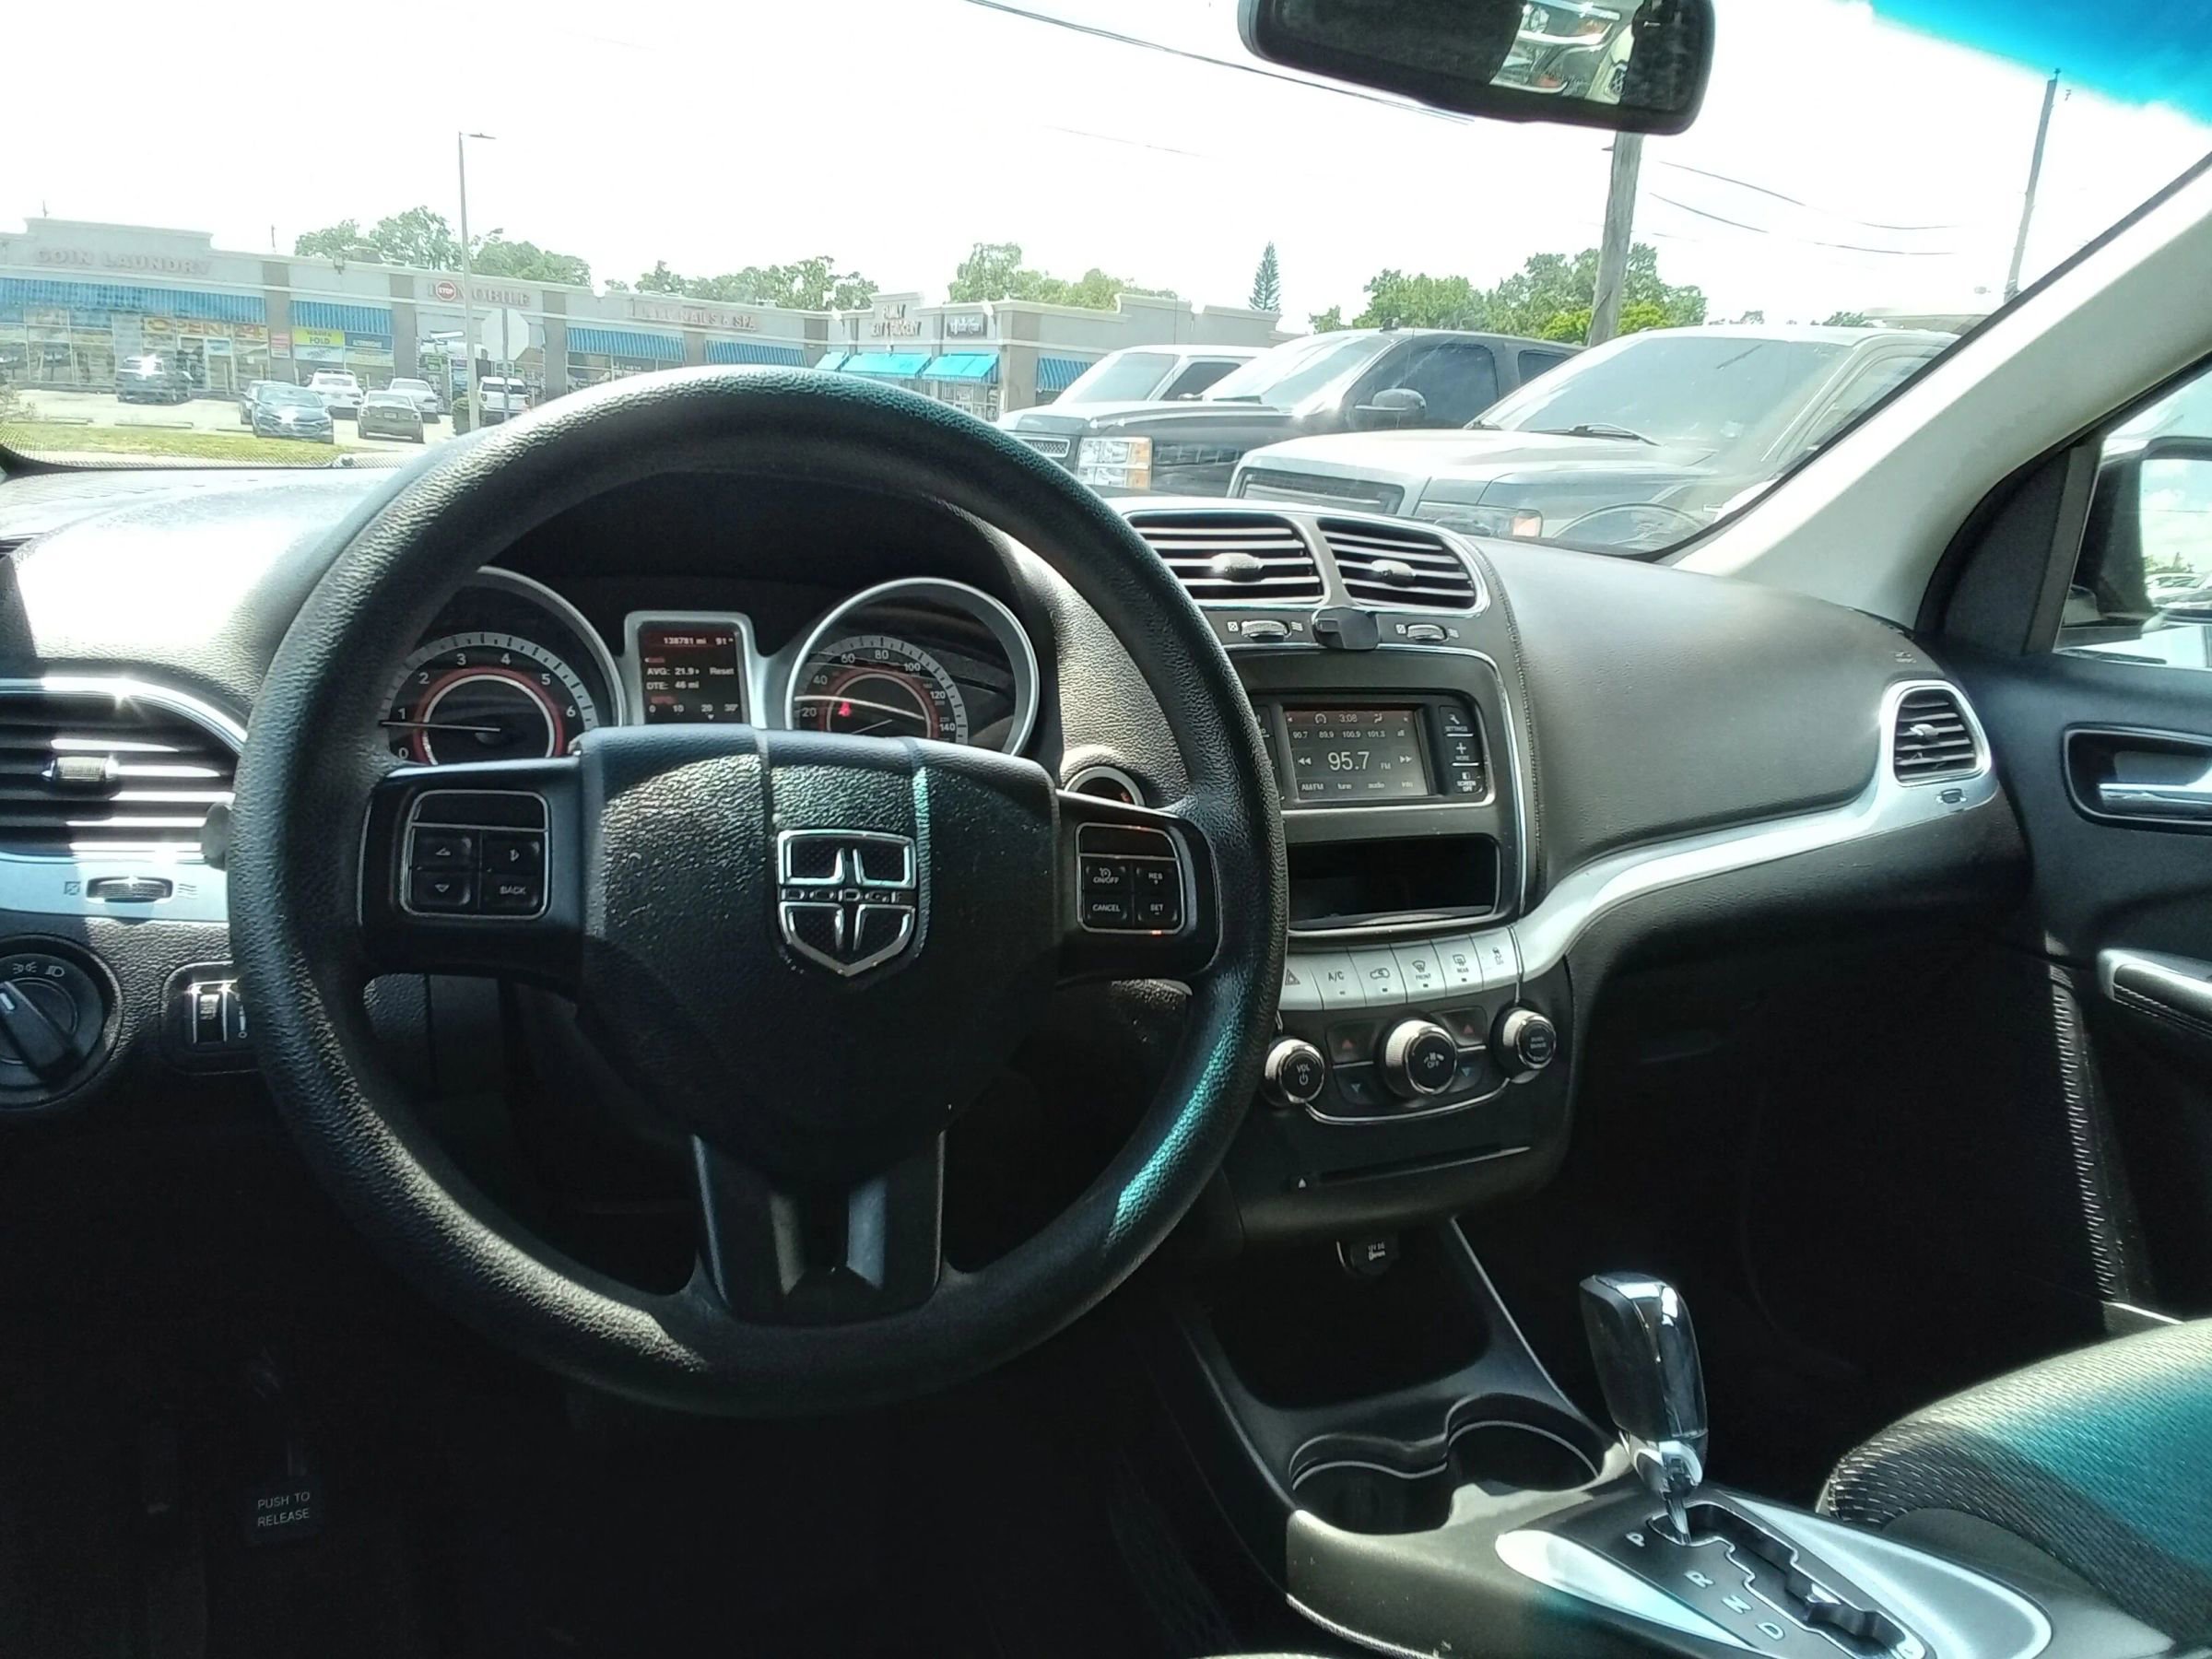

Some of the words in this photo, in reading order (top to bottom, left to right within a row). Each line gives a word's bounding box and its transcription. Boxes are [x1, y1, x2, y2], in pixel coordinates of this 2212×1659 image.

[102, 253, 213, 275] LAUNDRY
[438, 287, 453, 295] STOP
[677, 309, 717, 324] NAILS
[733, 314, 757, 329] SPA
[309, 336, 331, 345] FOLD
[456, 653, 467, 665] 3
[500, 653, 512, 665] 4
[841, 653, 855, 664] 60
[875, 650, 889, 660] 80
[904, 662, 921, 671] 100
[418, 672, 430, 684] 2
[541, 673, 551, 685] 5
[813, 675, 828, 685] 40
[930, 690, 946, 700] 120
[397, 707, 406, 719] 1
[566, 705, 576, 717] 6
[649, 704, 656, 712] 0
[673, 704, 684, 712] 10
[700, 703, 713, 712] 20
[802, 707, 818, 717] 20
[939, 723, 956, 732] 140
[398, 747, 409, 759] 0
[1327, 751, 1371, 771] 95.7
[1148, 872, 1163, 880] RES
[500, 886, 526, 895] BACK
[781, 888, 907, 904] DODGE
[1092, 903, 1121, 912] CANCEL
[1149, 903, 1163, 912] SET
[1327, 971, 1345, 982] A/C
[1296, 1064, 1311, 1072] VOL
[258, 1495, 289, 1510] PUSH
[294, 1491, 311, 1503] TO
[257, 1508, 310, 1527] RELEASE
[1626, 1532, 1645, 1547] P
[1684, 1571, 1714, 1588] R
[1722, 1594, 1752, 1614] N
[1756, 1622, 1786, 1641] D
